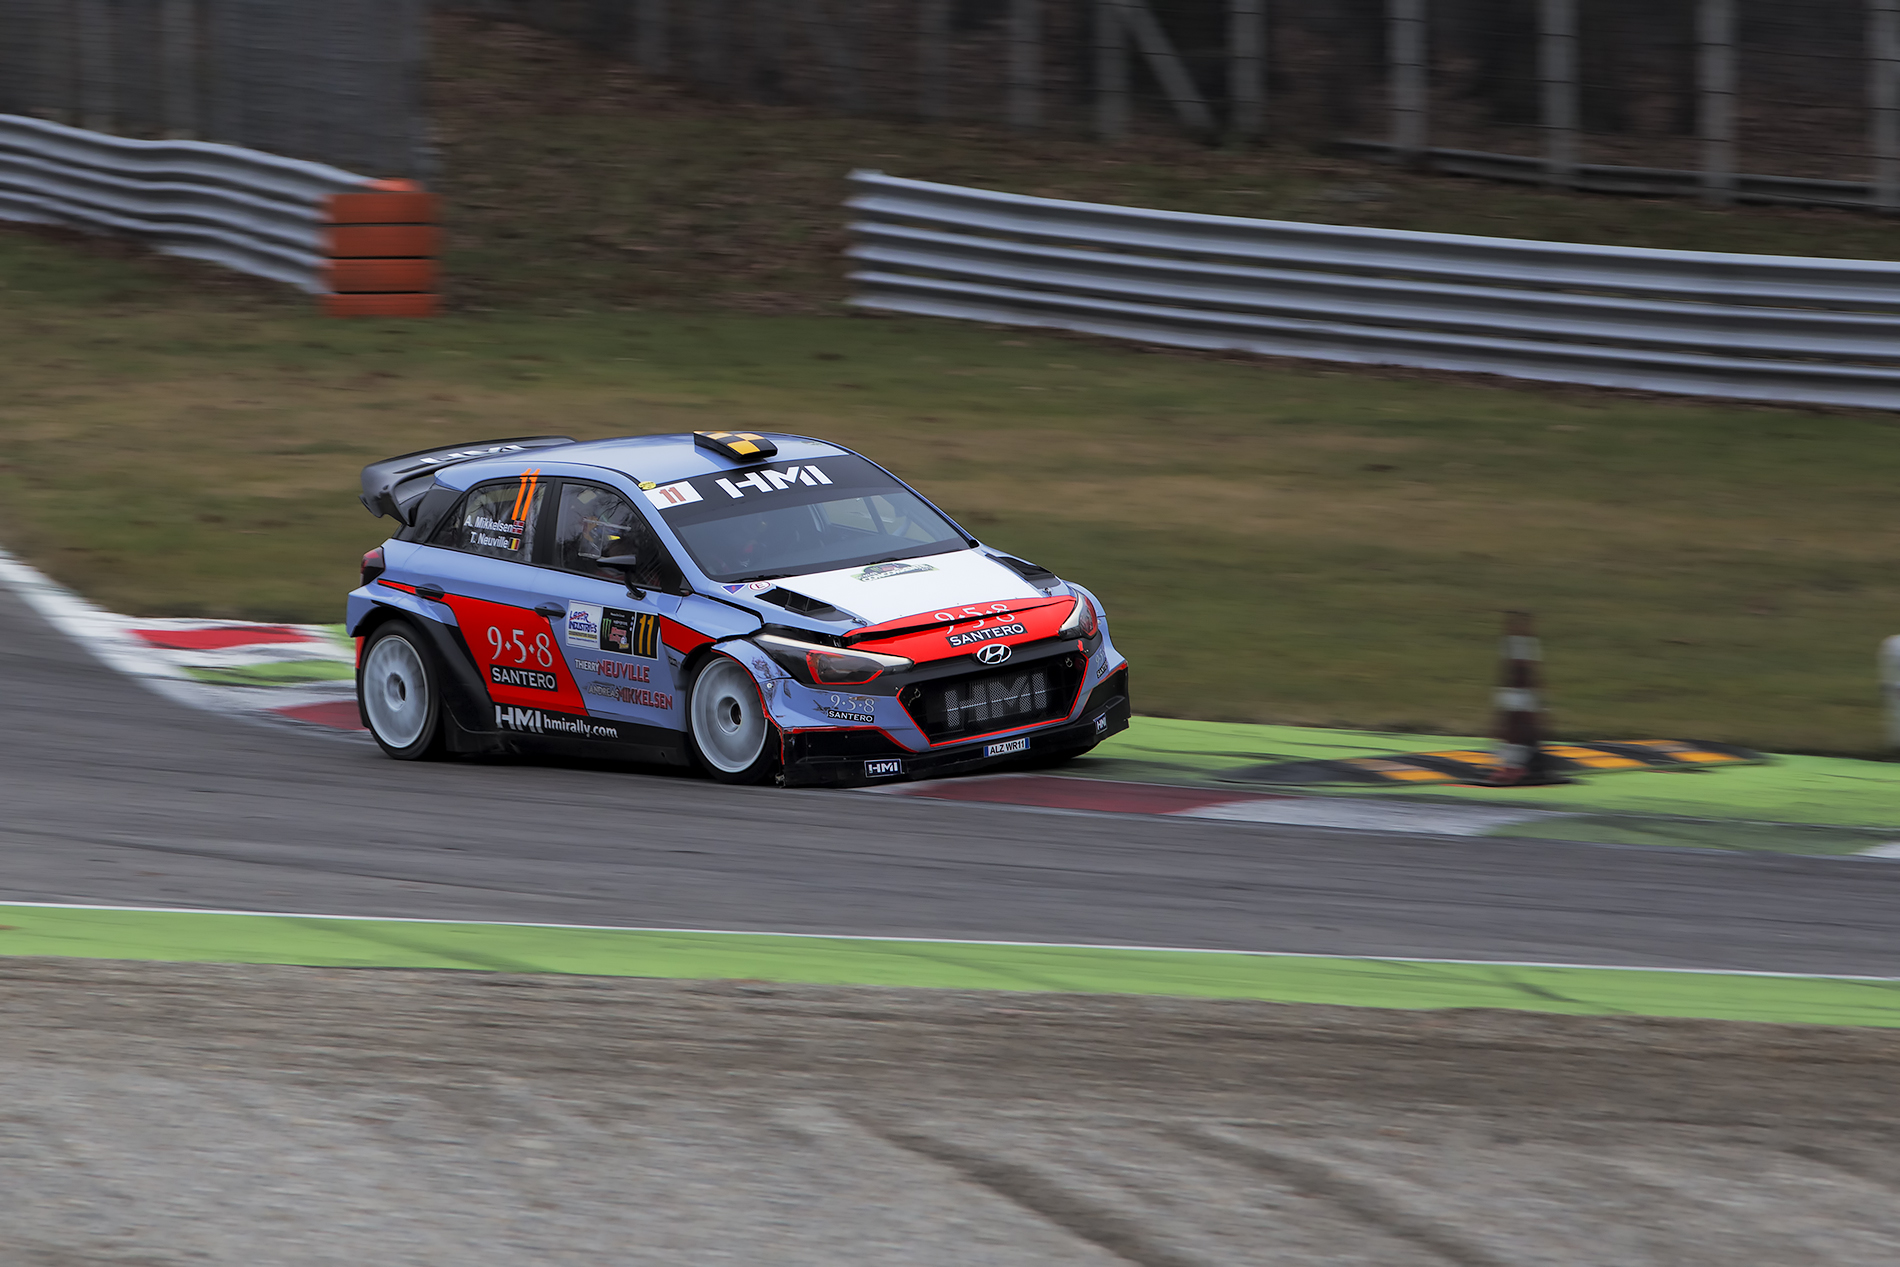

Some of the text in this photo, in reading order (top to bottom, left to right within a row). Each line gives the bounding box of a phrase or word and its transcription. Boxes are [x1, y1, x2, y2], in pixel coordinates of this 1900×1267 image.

[715, 465, 833, 499] HMI
[511, 468, 540, 521] 11
[659, 487, 686, 504] 11
[464, 515, 514, 534] A. Mikkelsen
[470, 531, 509, 548] T. Neuville
[638, 614, 655, 656] 11
[950, 625, 1024, 646] SANTERO
[492, 667, 556, 689] SANTERO
[575, 659, 599, 672] THIERRY
[597, 659, 650, 683] NEUVILLE
[588, 685, 673, 710] ANDREAS MIKKELSEN
[944, 672, 1047, 728] HMI
[495, 705, 618, 738] HMI hmirally.com
[828, 710, 873, 722] SANTERO
[989, 740, 1025, 755] ALZ WR11
[868, 761, 898, 774] HMI
